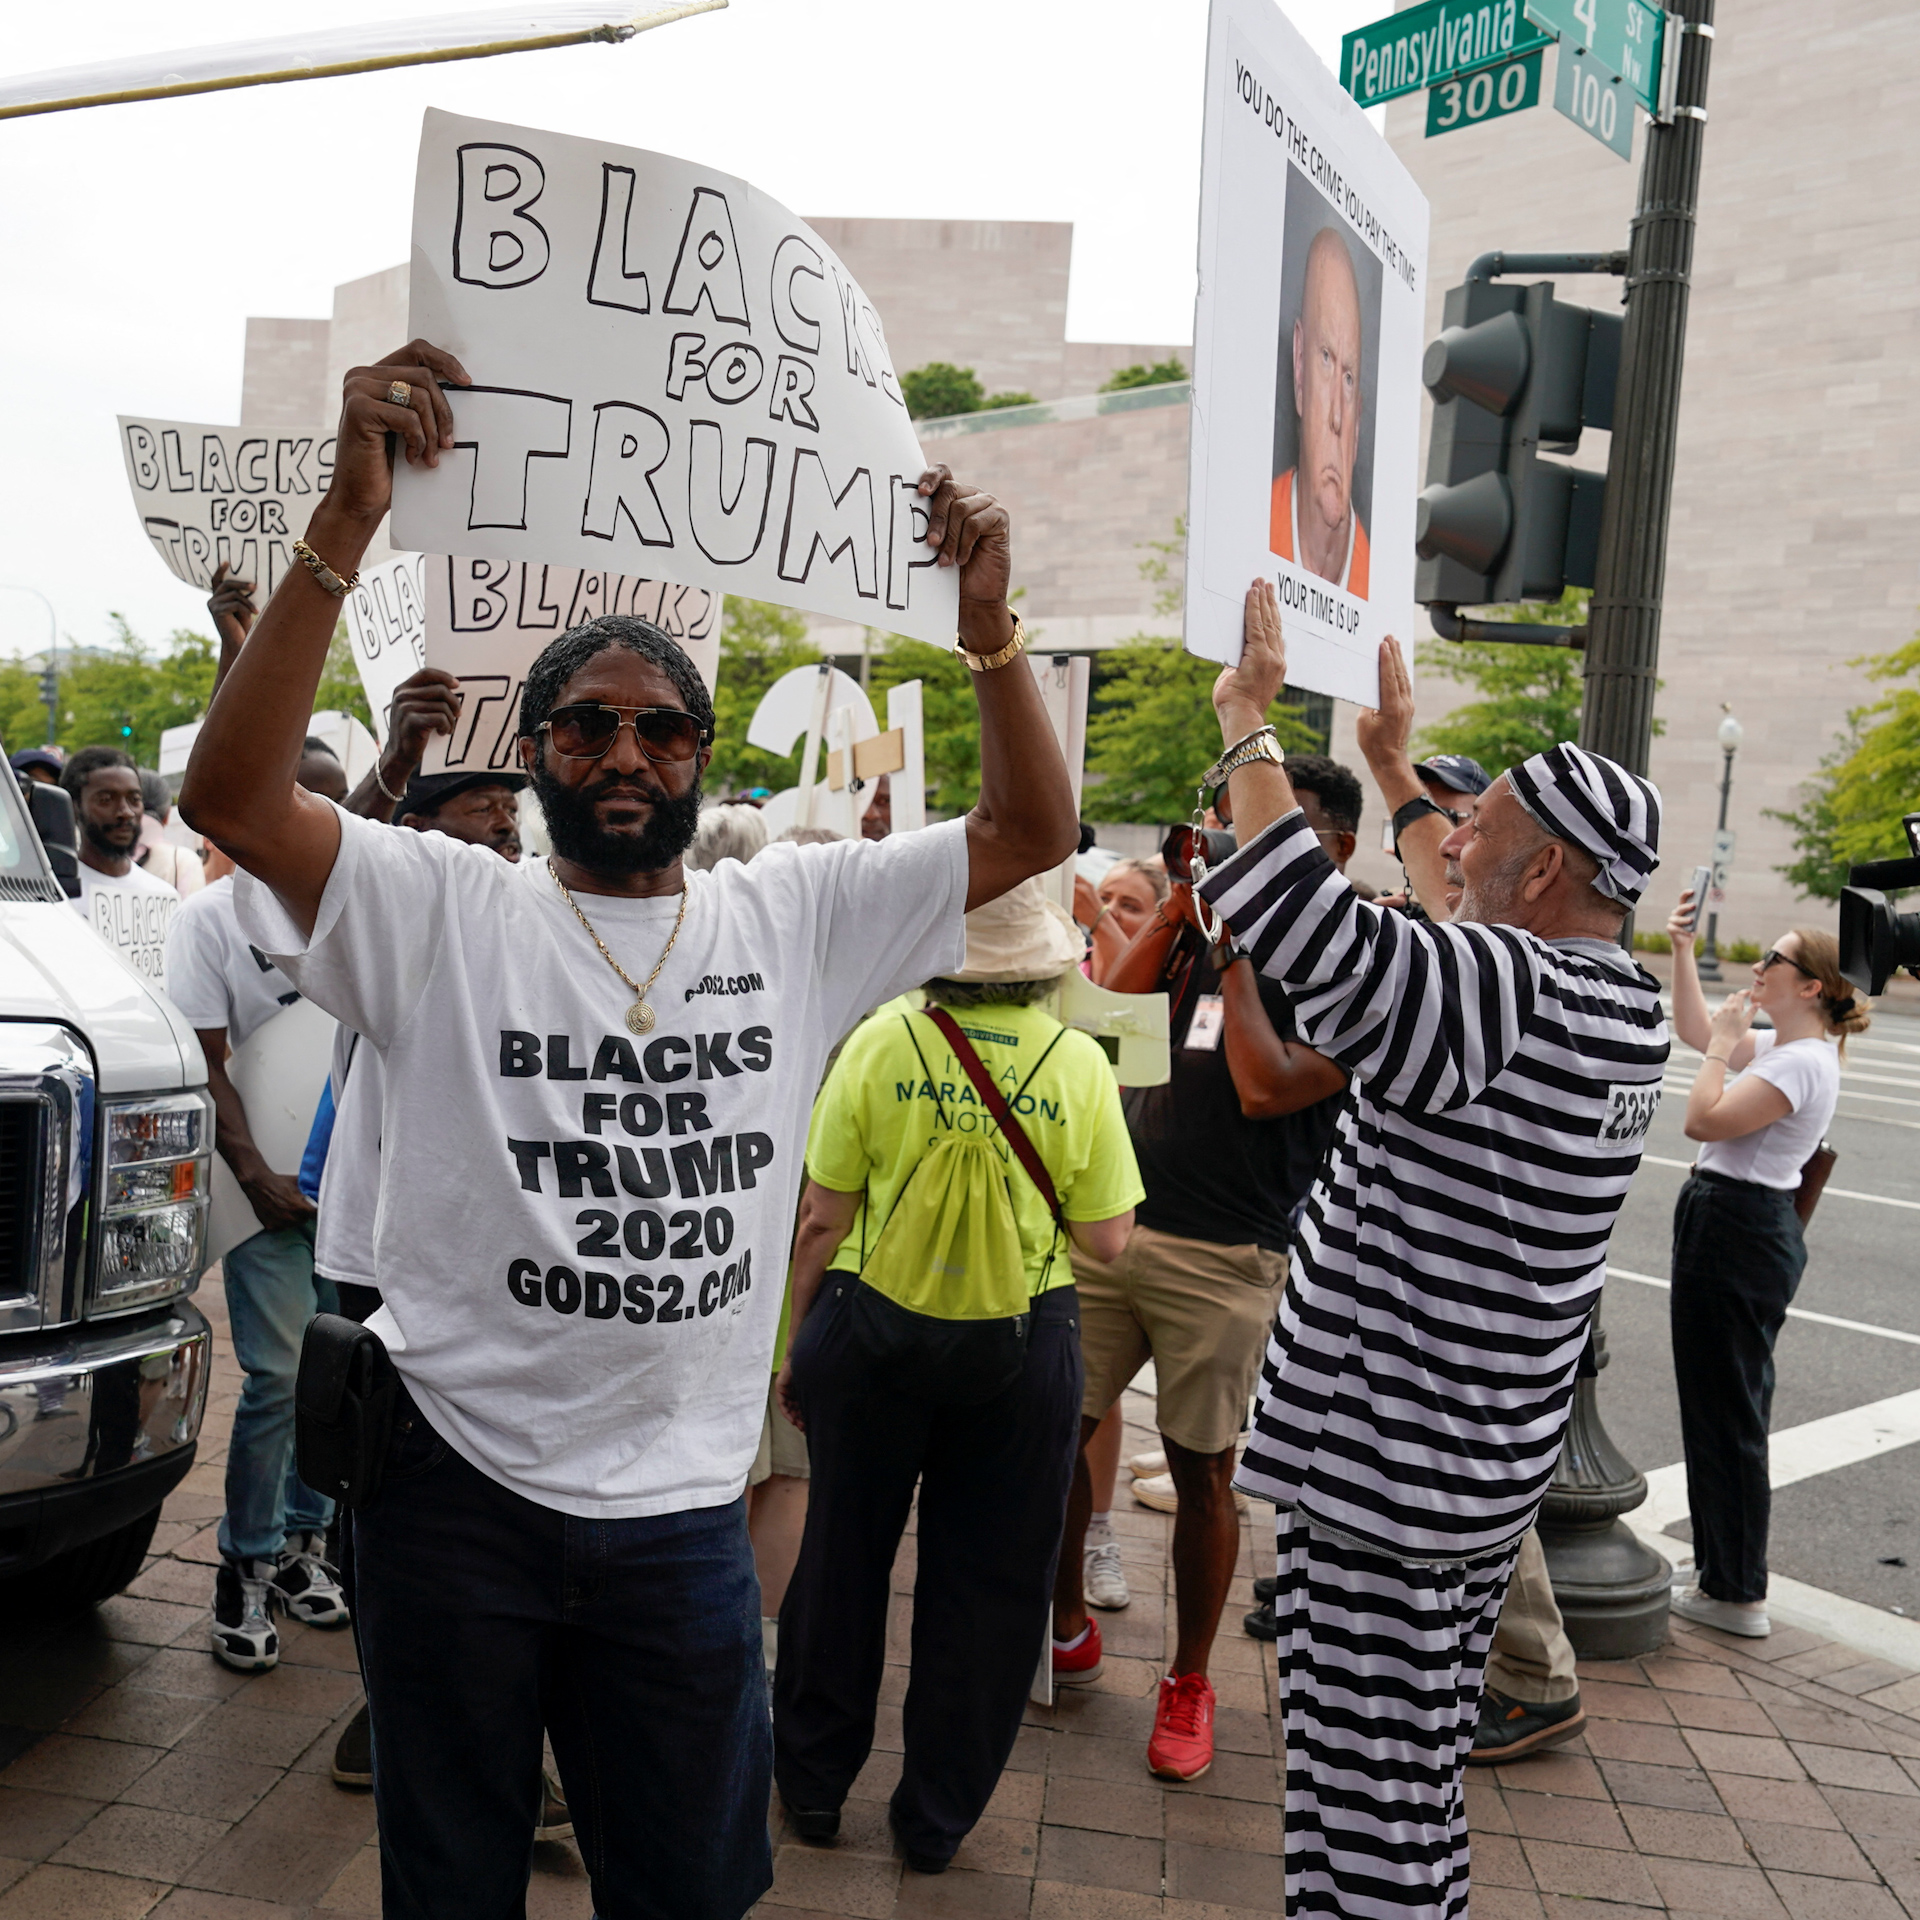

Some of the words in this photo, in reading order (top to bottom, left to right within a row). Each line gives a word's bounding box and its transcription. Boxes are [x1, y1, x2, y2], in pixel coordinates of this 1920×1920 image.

[1351, 0, 1518, 98] Pennsylvania
[1573, 0, 1597, 50] 4
[1625, 2, 1644, 44] St
[1436, 63, 1528, 127] 300
[1571, 63, 1617, 142] 100
[1235, 58, 1263, 115] YOU
[1265, 94, 1284, 138] DO
[1287, 116, 1309, 167] THE
[1310, 146, 1343, 206] CRIME
[1344, 183, 1364, 229] YOU
[1365, 208, 1382, 248] PAY
[1382, 229, 1397, 270] THE
[1398, 248, 1416, 293] TIME
[453, 142, 906, 408] BLACKS
[666, 332, 820, 434] FOR
[127, 425, 337, 494] BLACKS
[211, 499, 289, 535] FOR
[440, 381, 942, 611] TRUMP
[353, 554, 425, 659] BLA
[1278, 572, 1307, 613] YOUR
[1310, 588, 1334, 626] TIME
[1336, 601, 1345, 630] IS
[1347, 606, 1360, 636] UP
[131, 948, 164, 978] FOR
[500, 1025, 773, 1084] BLACKS
[963, 1028, 1018, 1046] NDIVISIBLE
[896, 1080, 1067, 1127] MARAON,
[1000, 1065, 1018, 1085] A
[583, 1091, 714, 1137] FOR
[934, 1109, 994, 1135] NOT
[507, 1131, 775, 1200] TRUMP
[575, 1206, 734, 1261] 2020
[507, 1248, 751, 1324] GODS2.COM
